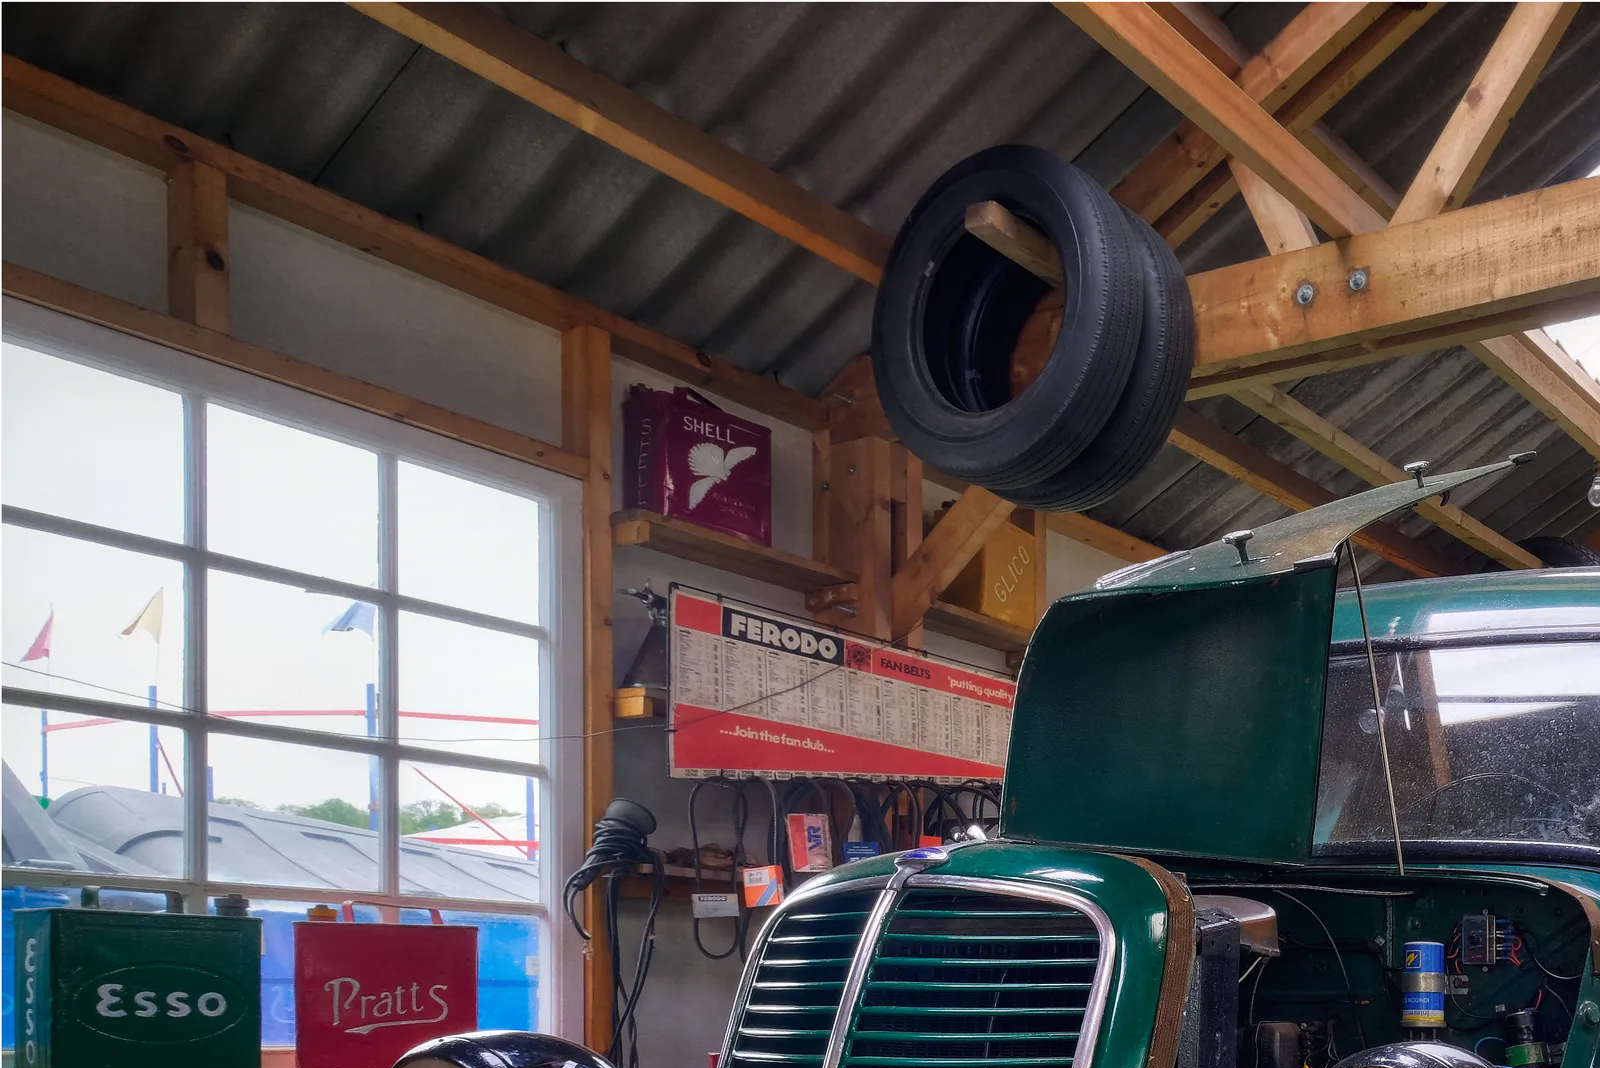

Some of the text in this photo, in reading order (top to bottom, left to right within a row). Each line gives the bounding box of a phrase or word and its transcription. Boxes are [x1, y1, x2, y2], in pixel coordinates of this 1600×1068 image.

[683, 415, 736, 445] SHELL
[637, 418, 652, 505] SHELL
[994, 545, 1030, 602] GLICO
[730, 613, 838, 660] FERODO
[881, 657, 931, 680] FAN BELTS
[760, 730, 780, 744] the
[780, 734, 801, 747] fan
[324, 976, 449, 1034] Pratts
